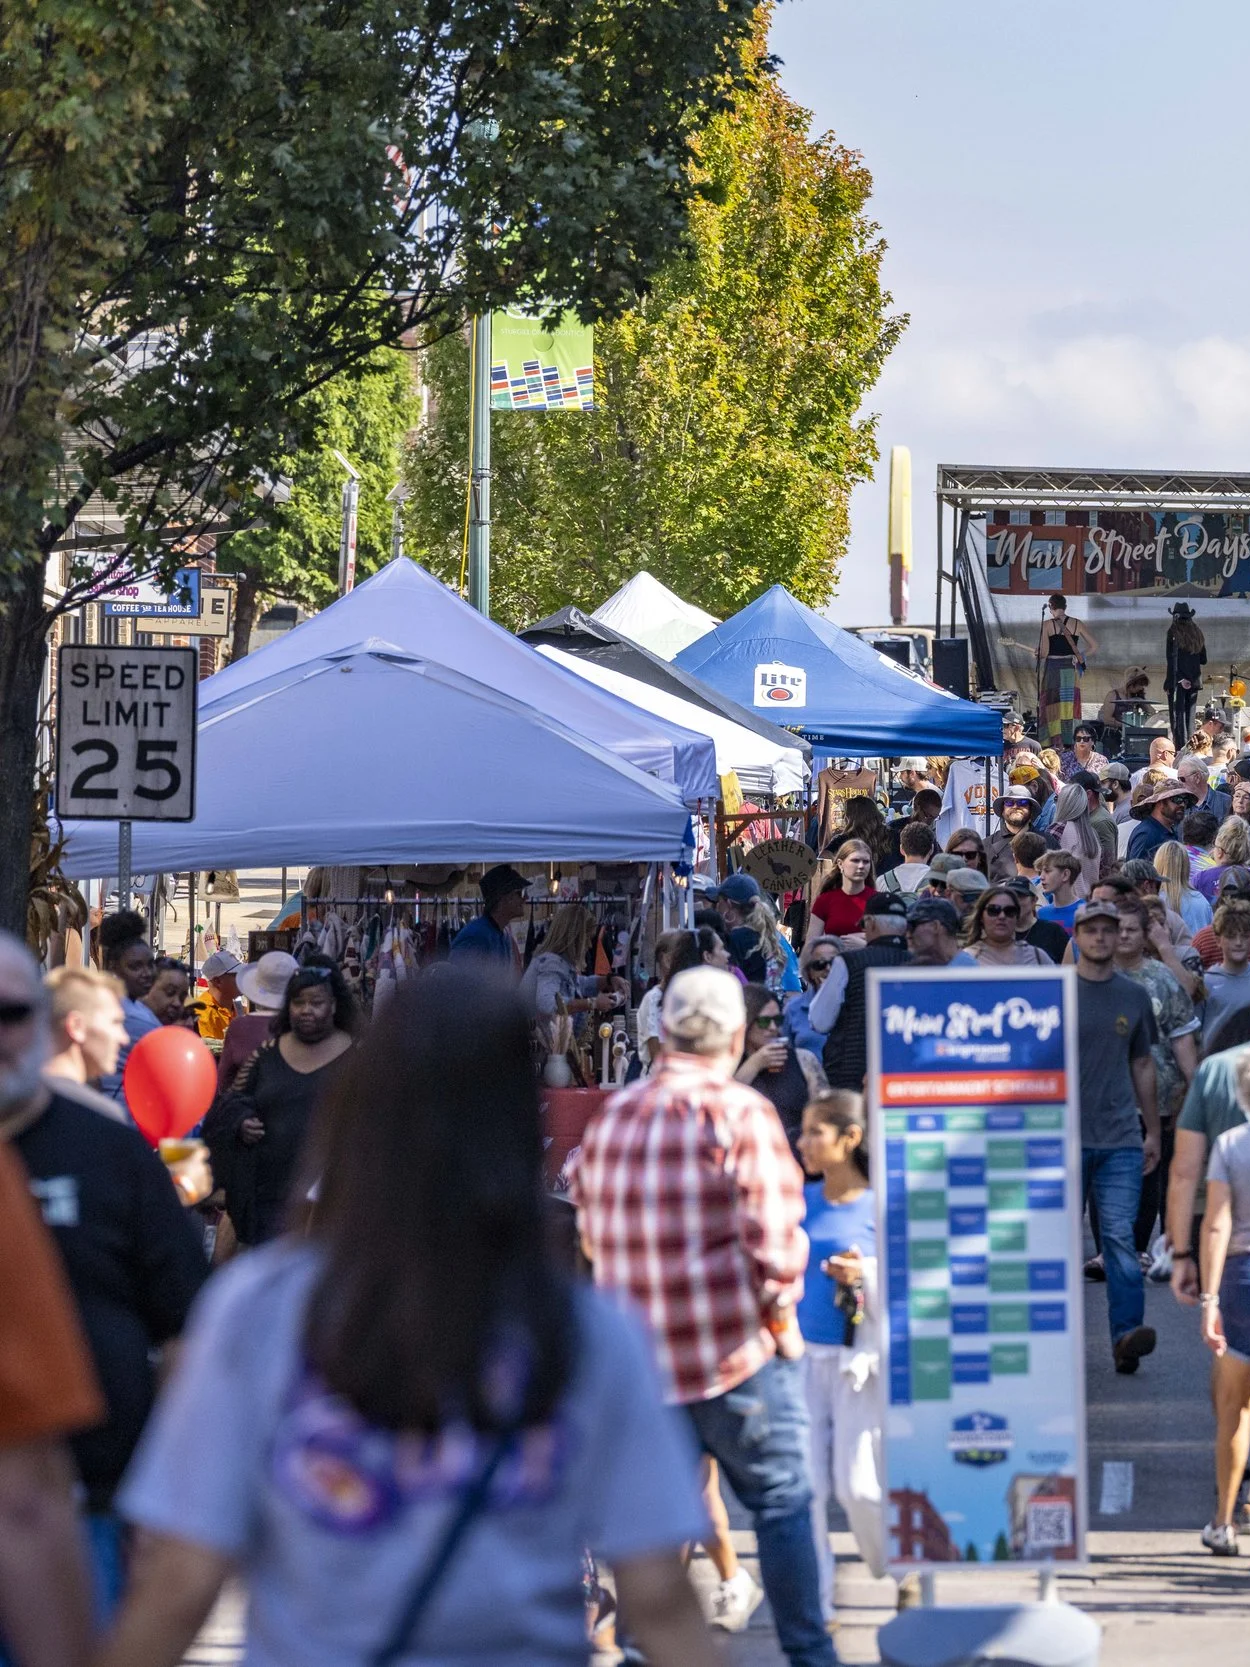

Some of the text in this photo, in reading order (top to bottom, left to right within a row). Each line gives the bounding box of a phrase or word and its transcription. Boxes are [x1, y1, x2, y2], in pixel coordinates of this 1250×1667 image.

[989, 528, 1077, 582] Main
[1084, 526, 1172, 575] Street
[112, 603, 140, 613] COFFEE
[154, 605, 167, 613] TEA
[167, 604, 192, 613] HOUSE
[70, 662, 185, 690] SPEED
[760, 672, 802, 687] Lite
[82, 700, 171, 728] LIMIT
[70, 738, 182, 801] 25
[752, 840, 806, 861] LEATHER
[762, 871, 809, 891] CANVAS
[1005, 996, 1062, 1042] Days
